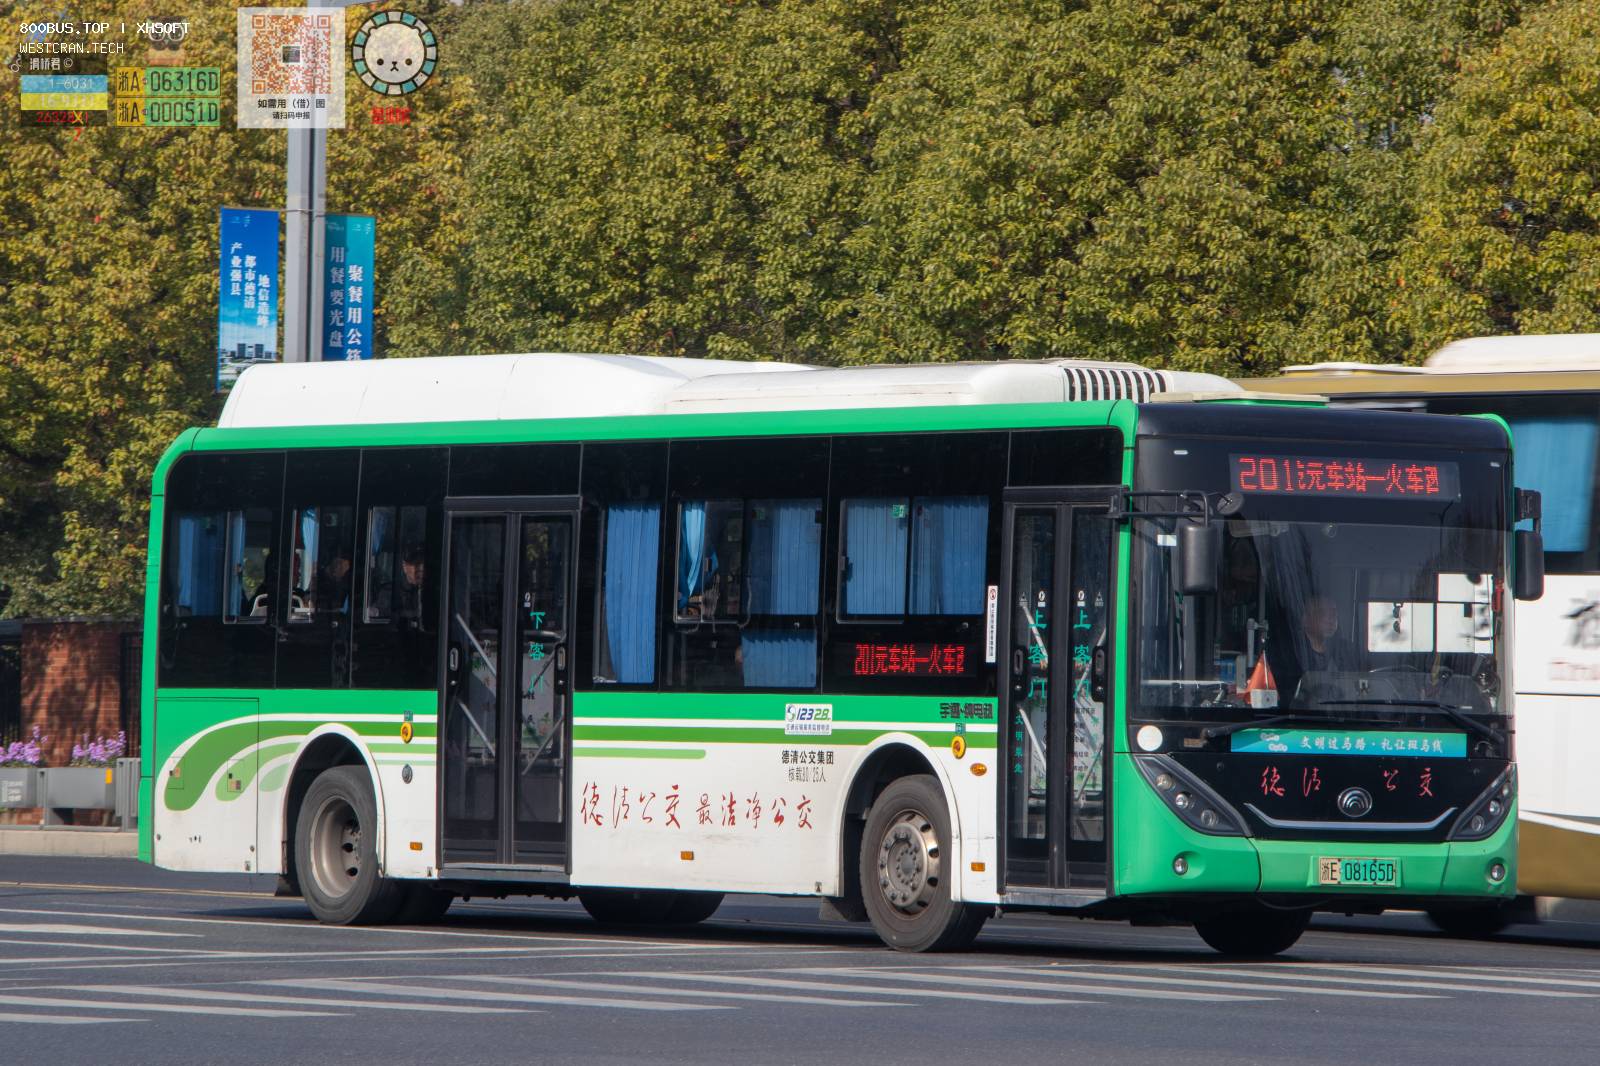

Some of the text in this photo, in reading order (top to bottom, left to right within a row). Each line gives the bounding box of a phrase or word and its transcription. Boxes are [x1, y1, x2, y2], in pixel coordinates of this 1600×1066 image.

[329, 246, 344, 348] 用餐要光盘
[796, 707, 830, 721] 12328
[781, 749, 834, 765] 德清公交集团
